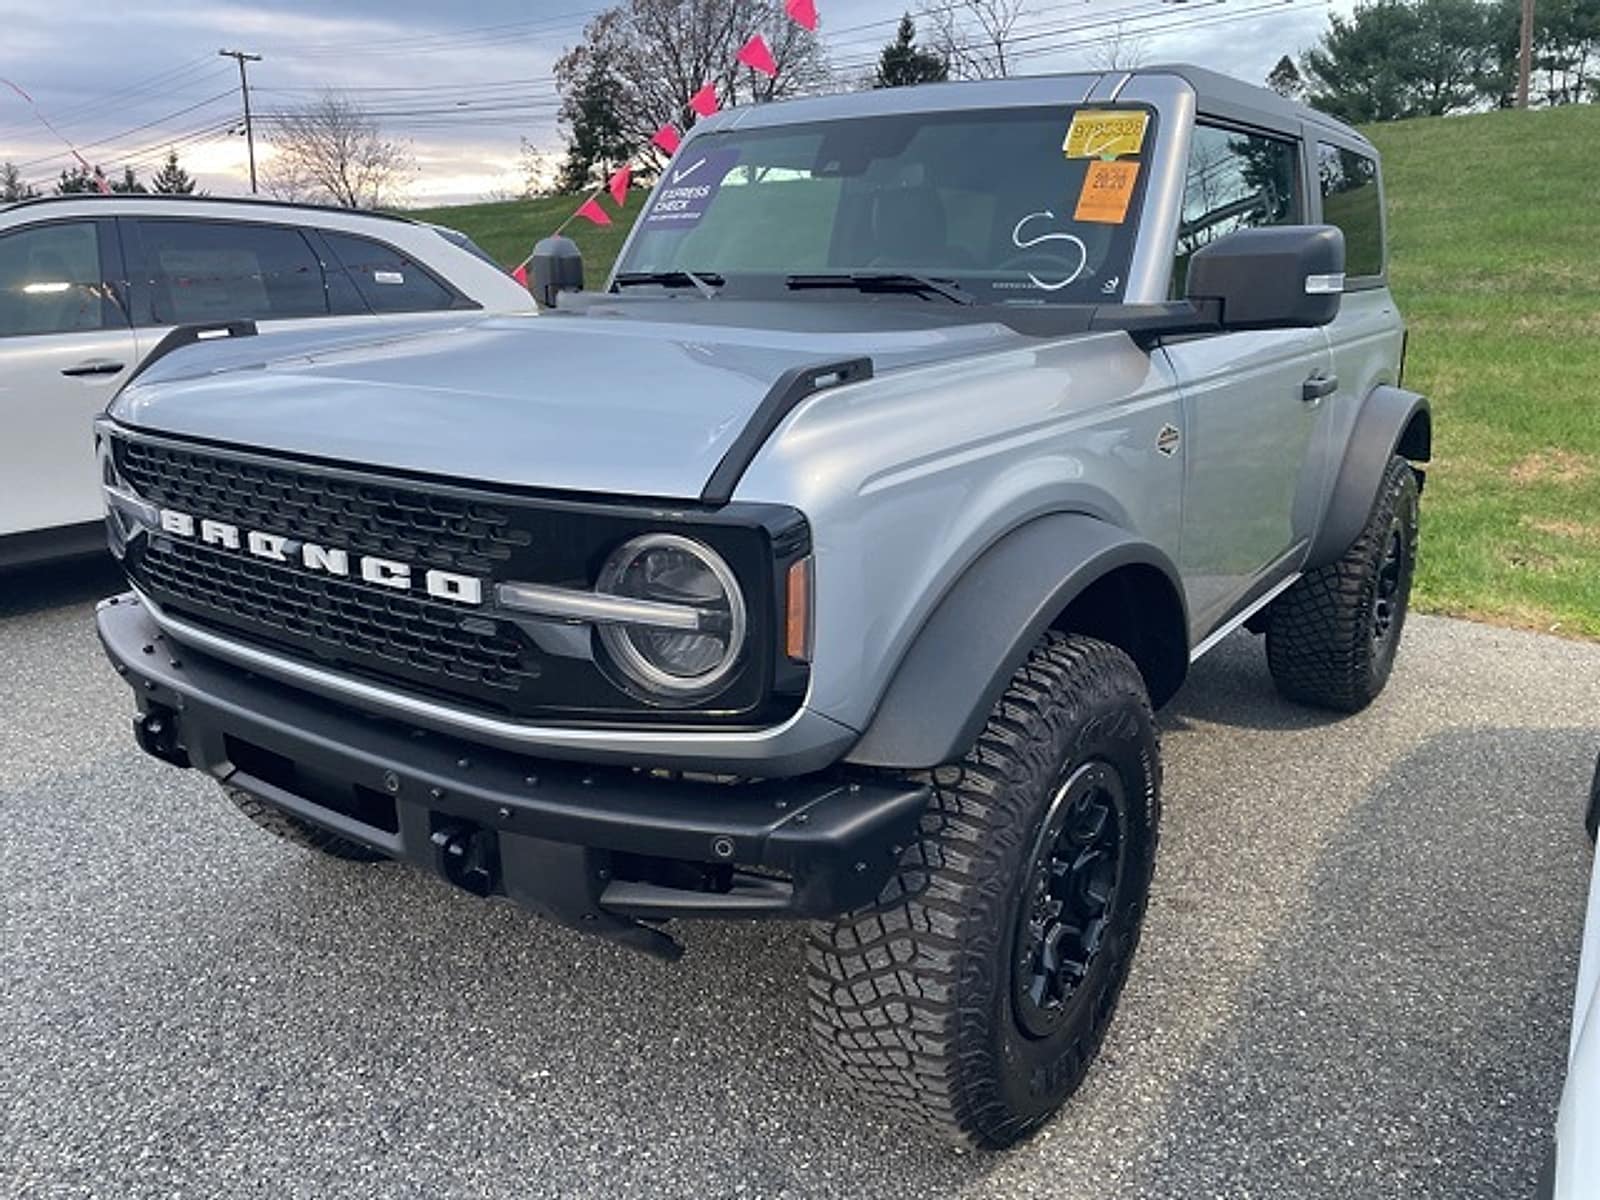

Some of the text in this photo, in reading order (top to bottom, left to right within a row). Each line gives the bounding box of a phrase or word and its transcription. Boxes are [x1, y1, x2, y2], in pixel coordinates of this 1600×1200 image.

[654, 200, 688, 211] CHECK
[660, 185, 711, 200] EXPRESS
[1012, 210, 1087, 290] S
[160, 509, 482, 604] BRONCO
